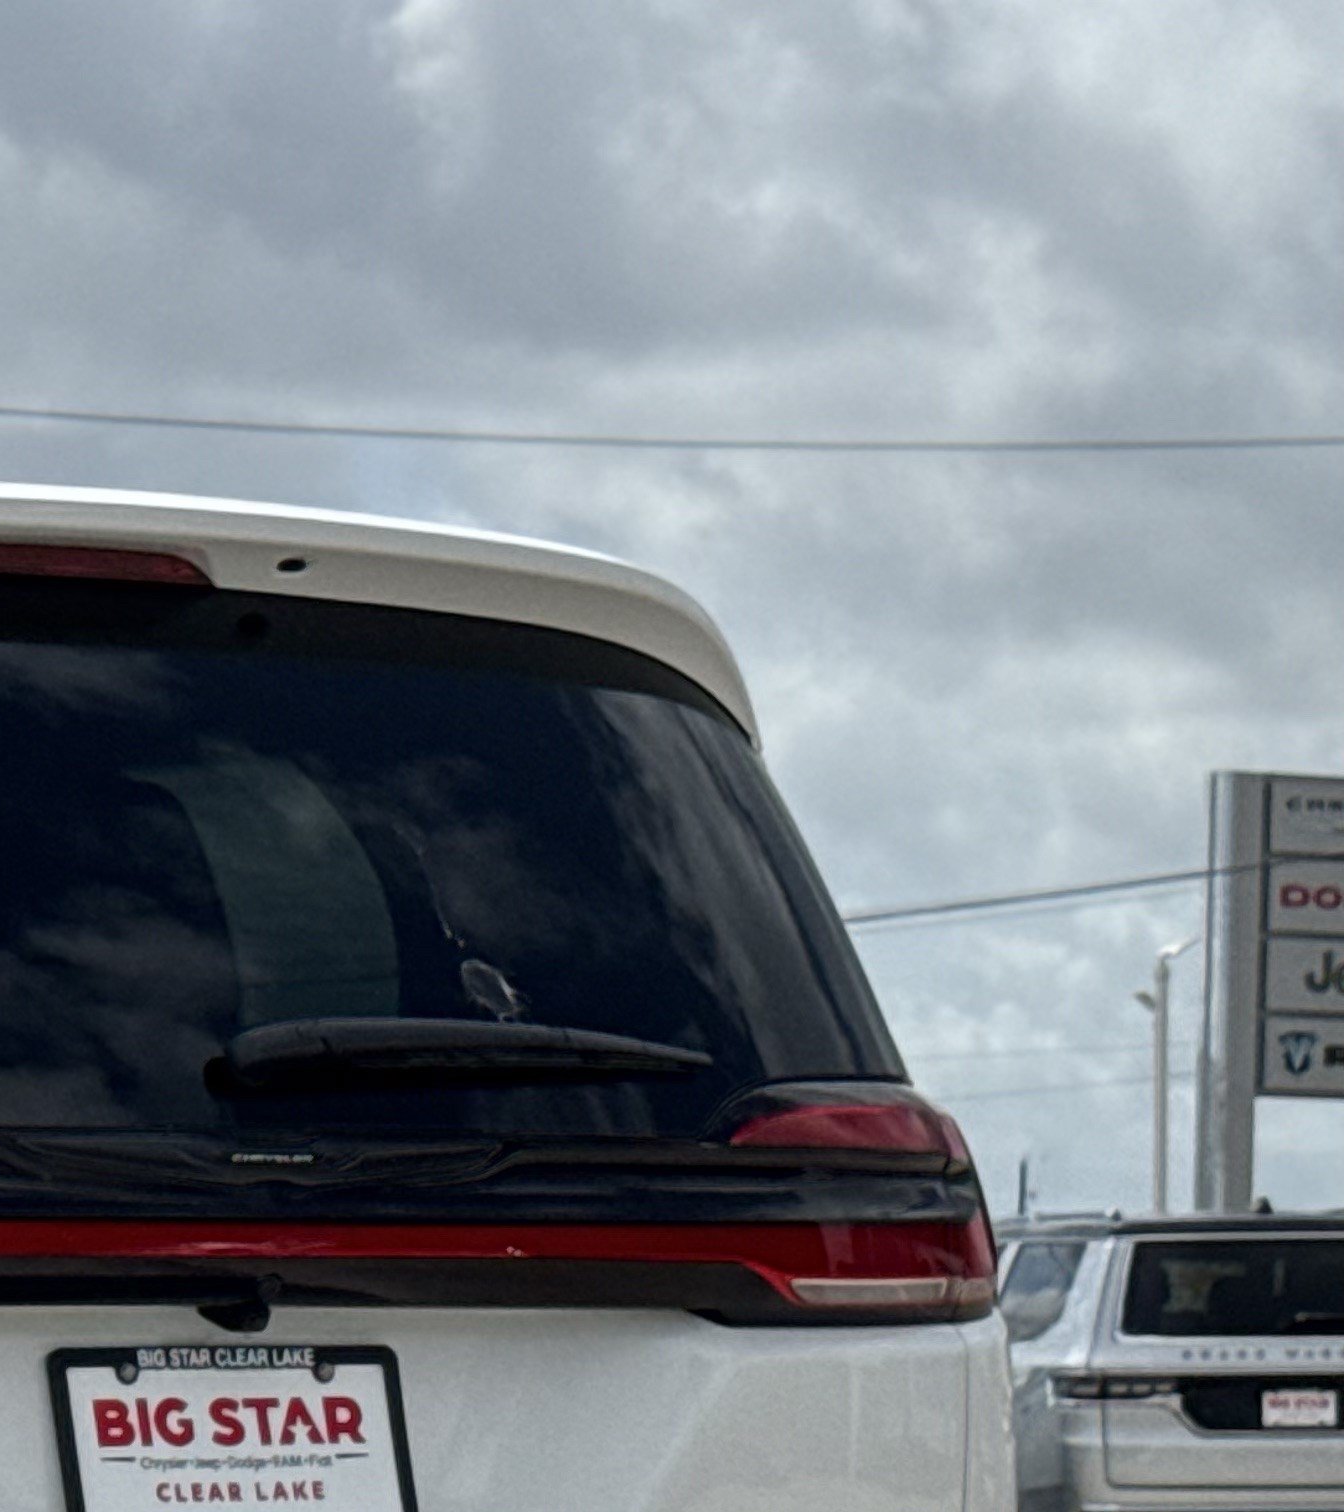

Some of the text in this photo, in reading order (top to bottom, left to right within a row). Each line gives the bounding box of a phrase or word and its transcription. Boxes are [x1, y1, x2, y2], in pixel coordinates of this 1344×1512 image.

[137, 1347, 315, 1367] BIG STAR CLEAR LAKE
[93, 1396, 366, 1447] BIG STAR
[156, 1480, 326, 1503] CLEAR LAKE
